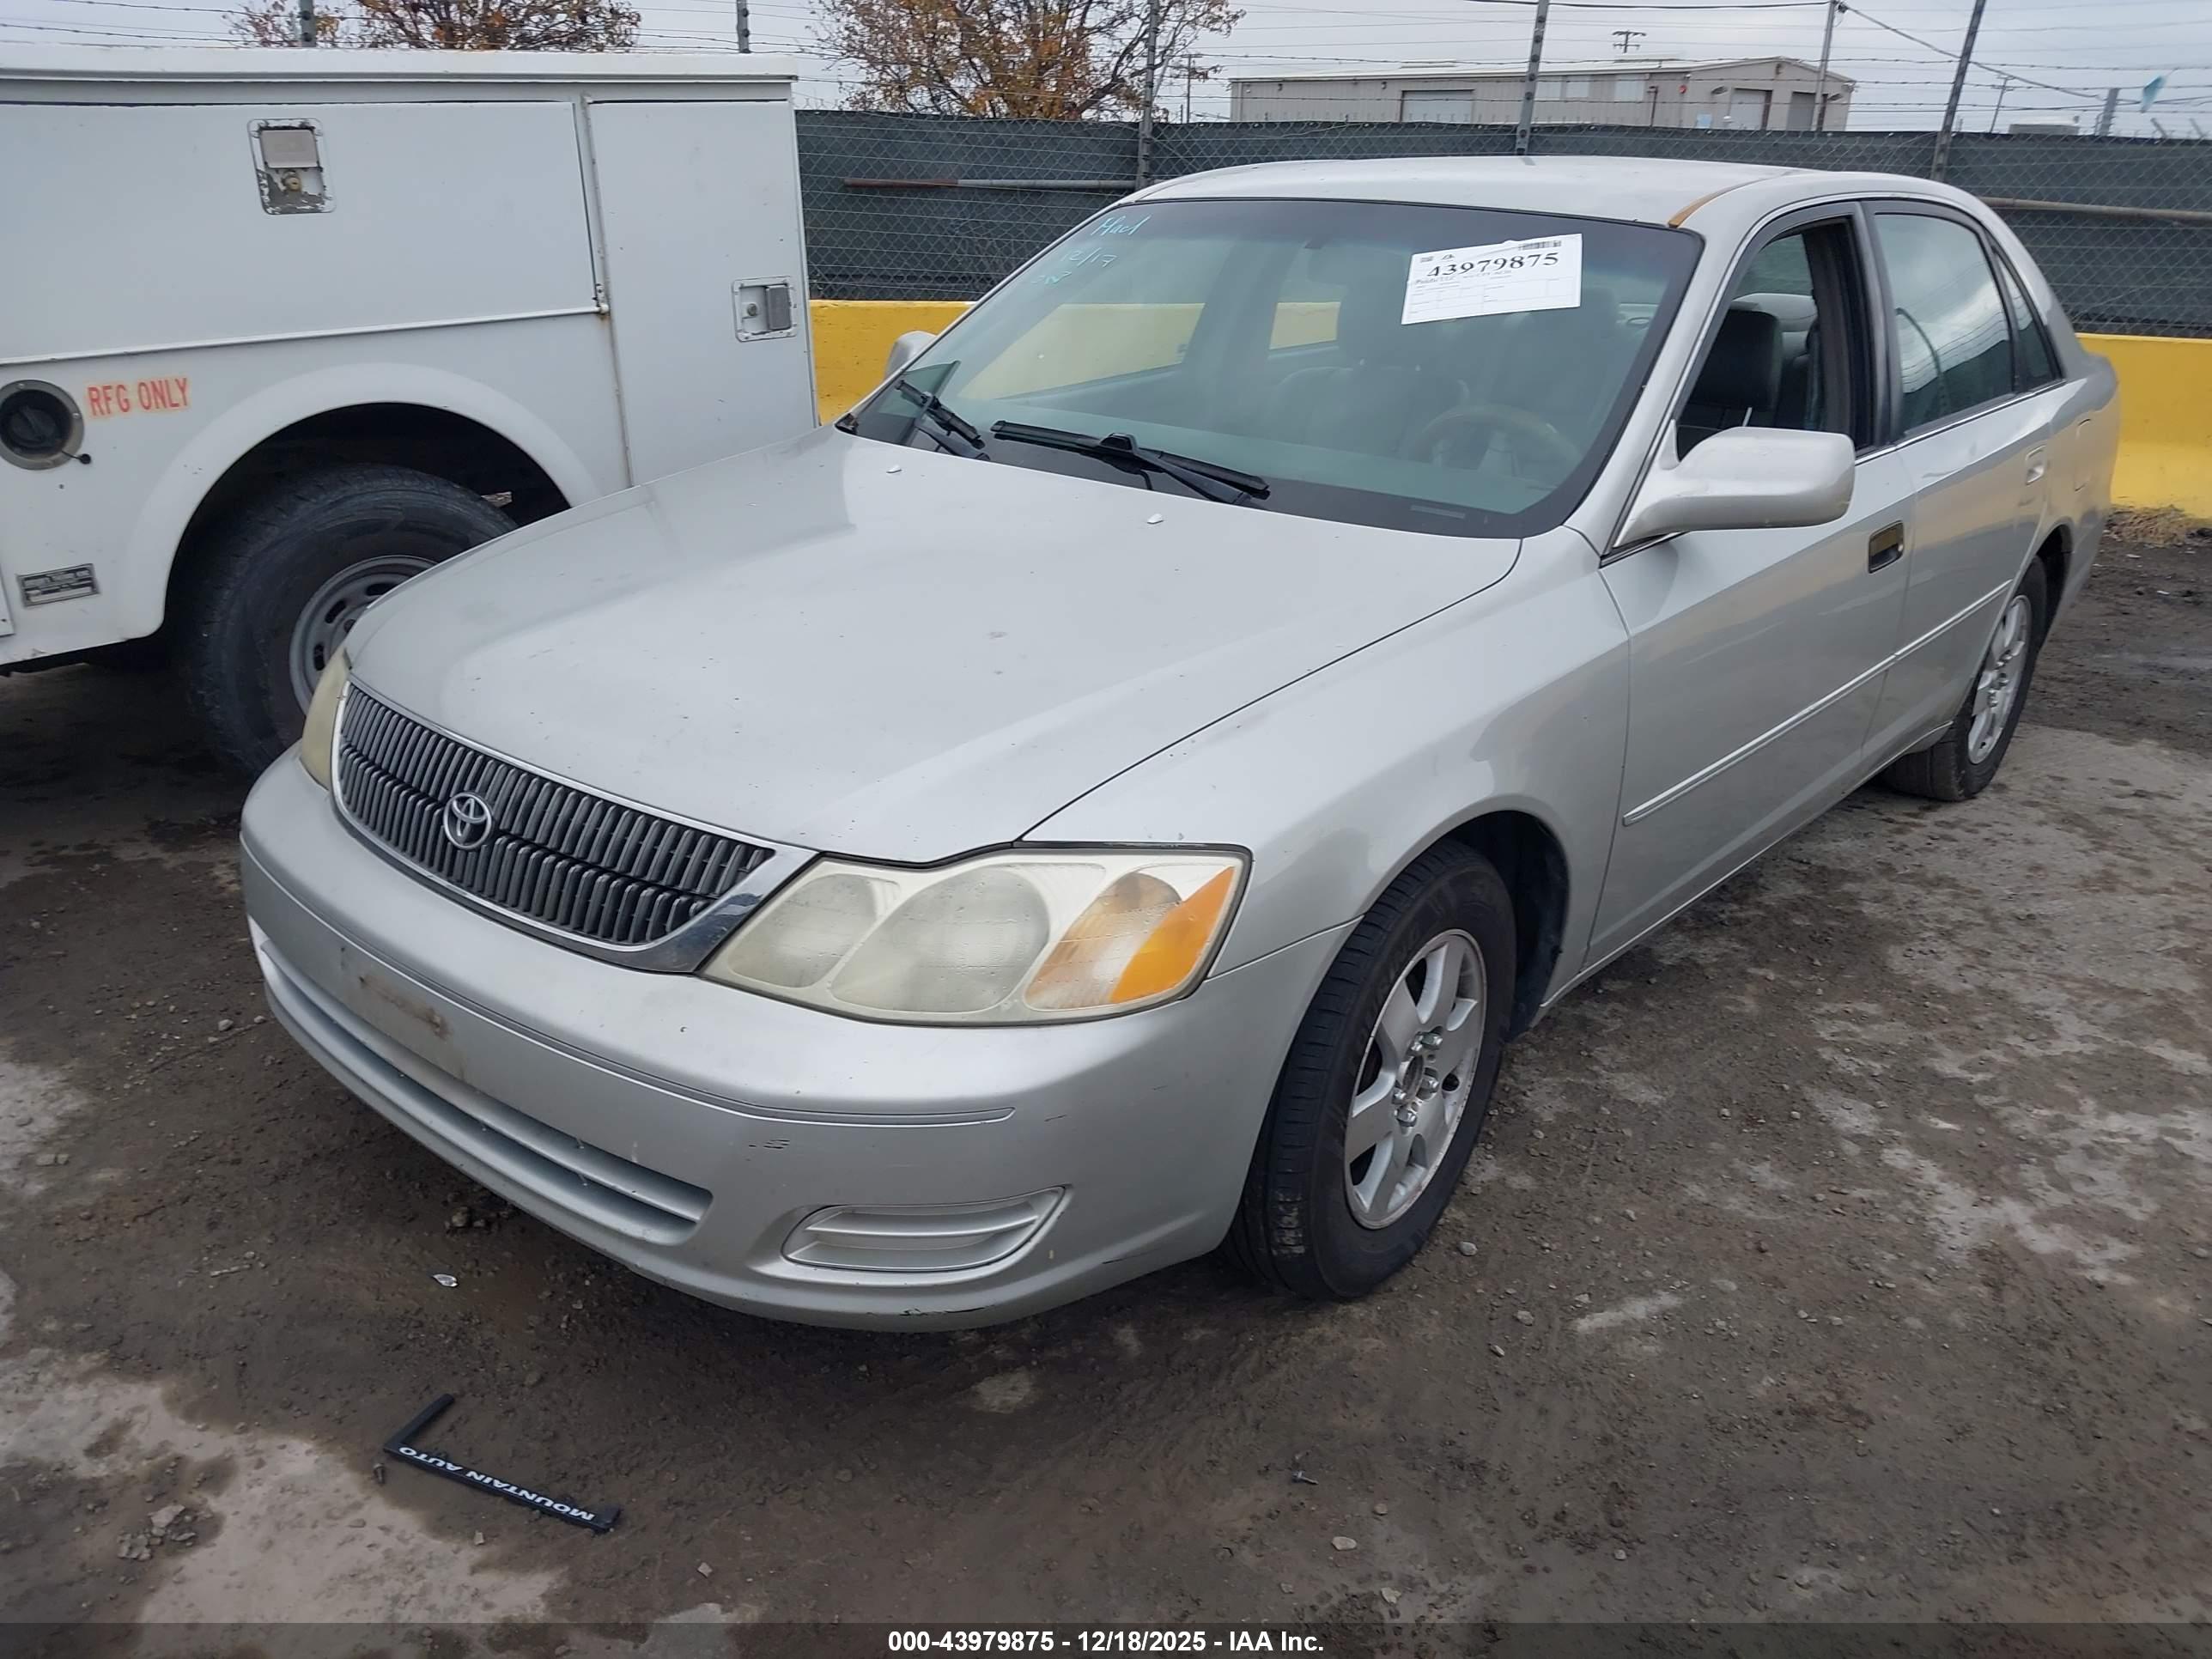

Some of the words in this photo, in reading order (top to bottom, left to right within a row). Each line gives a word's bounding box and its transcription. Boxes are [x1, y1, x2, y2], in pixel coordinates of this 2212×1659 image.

[1426, 252, 1559, 277] 43979875
[88, 385, 131, 416] RFG
[137, 378, 187, 410] ONLY
[398, 1446, 464, 1472] AUTO
[465, 1469, 595, 1522] MOUNTAIN
